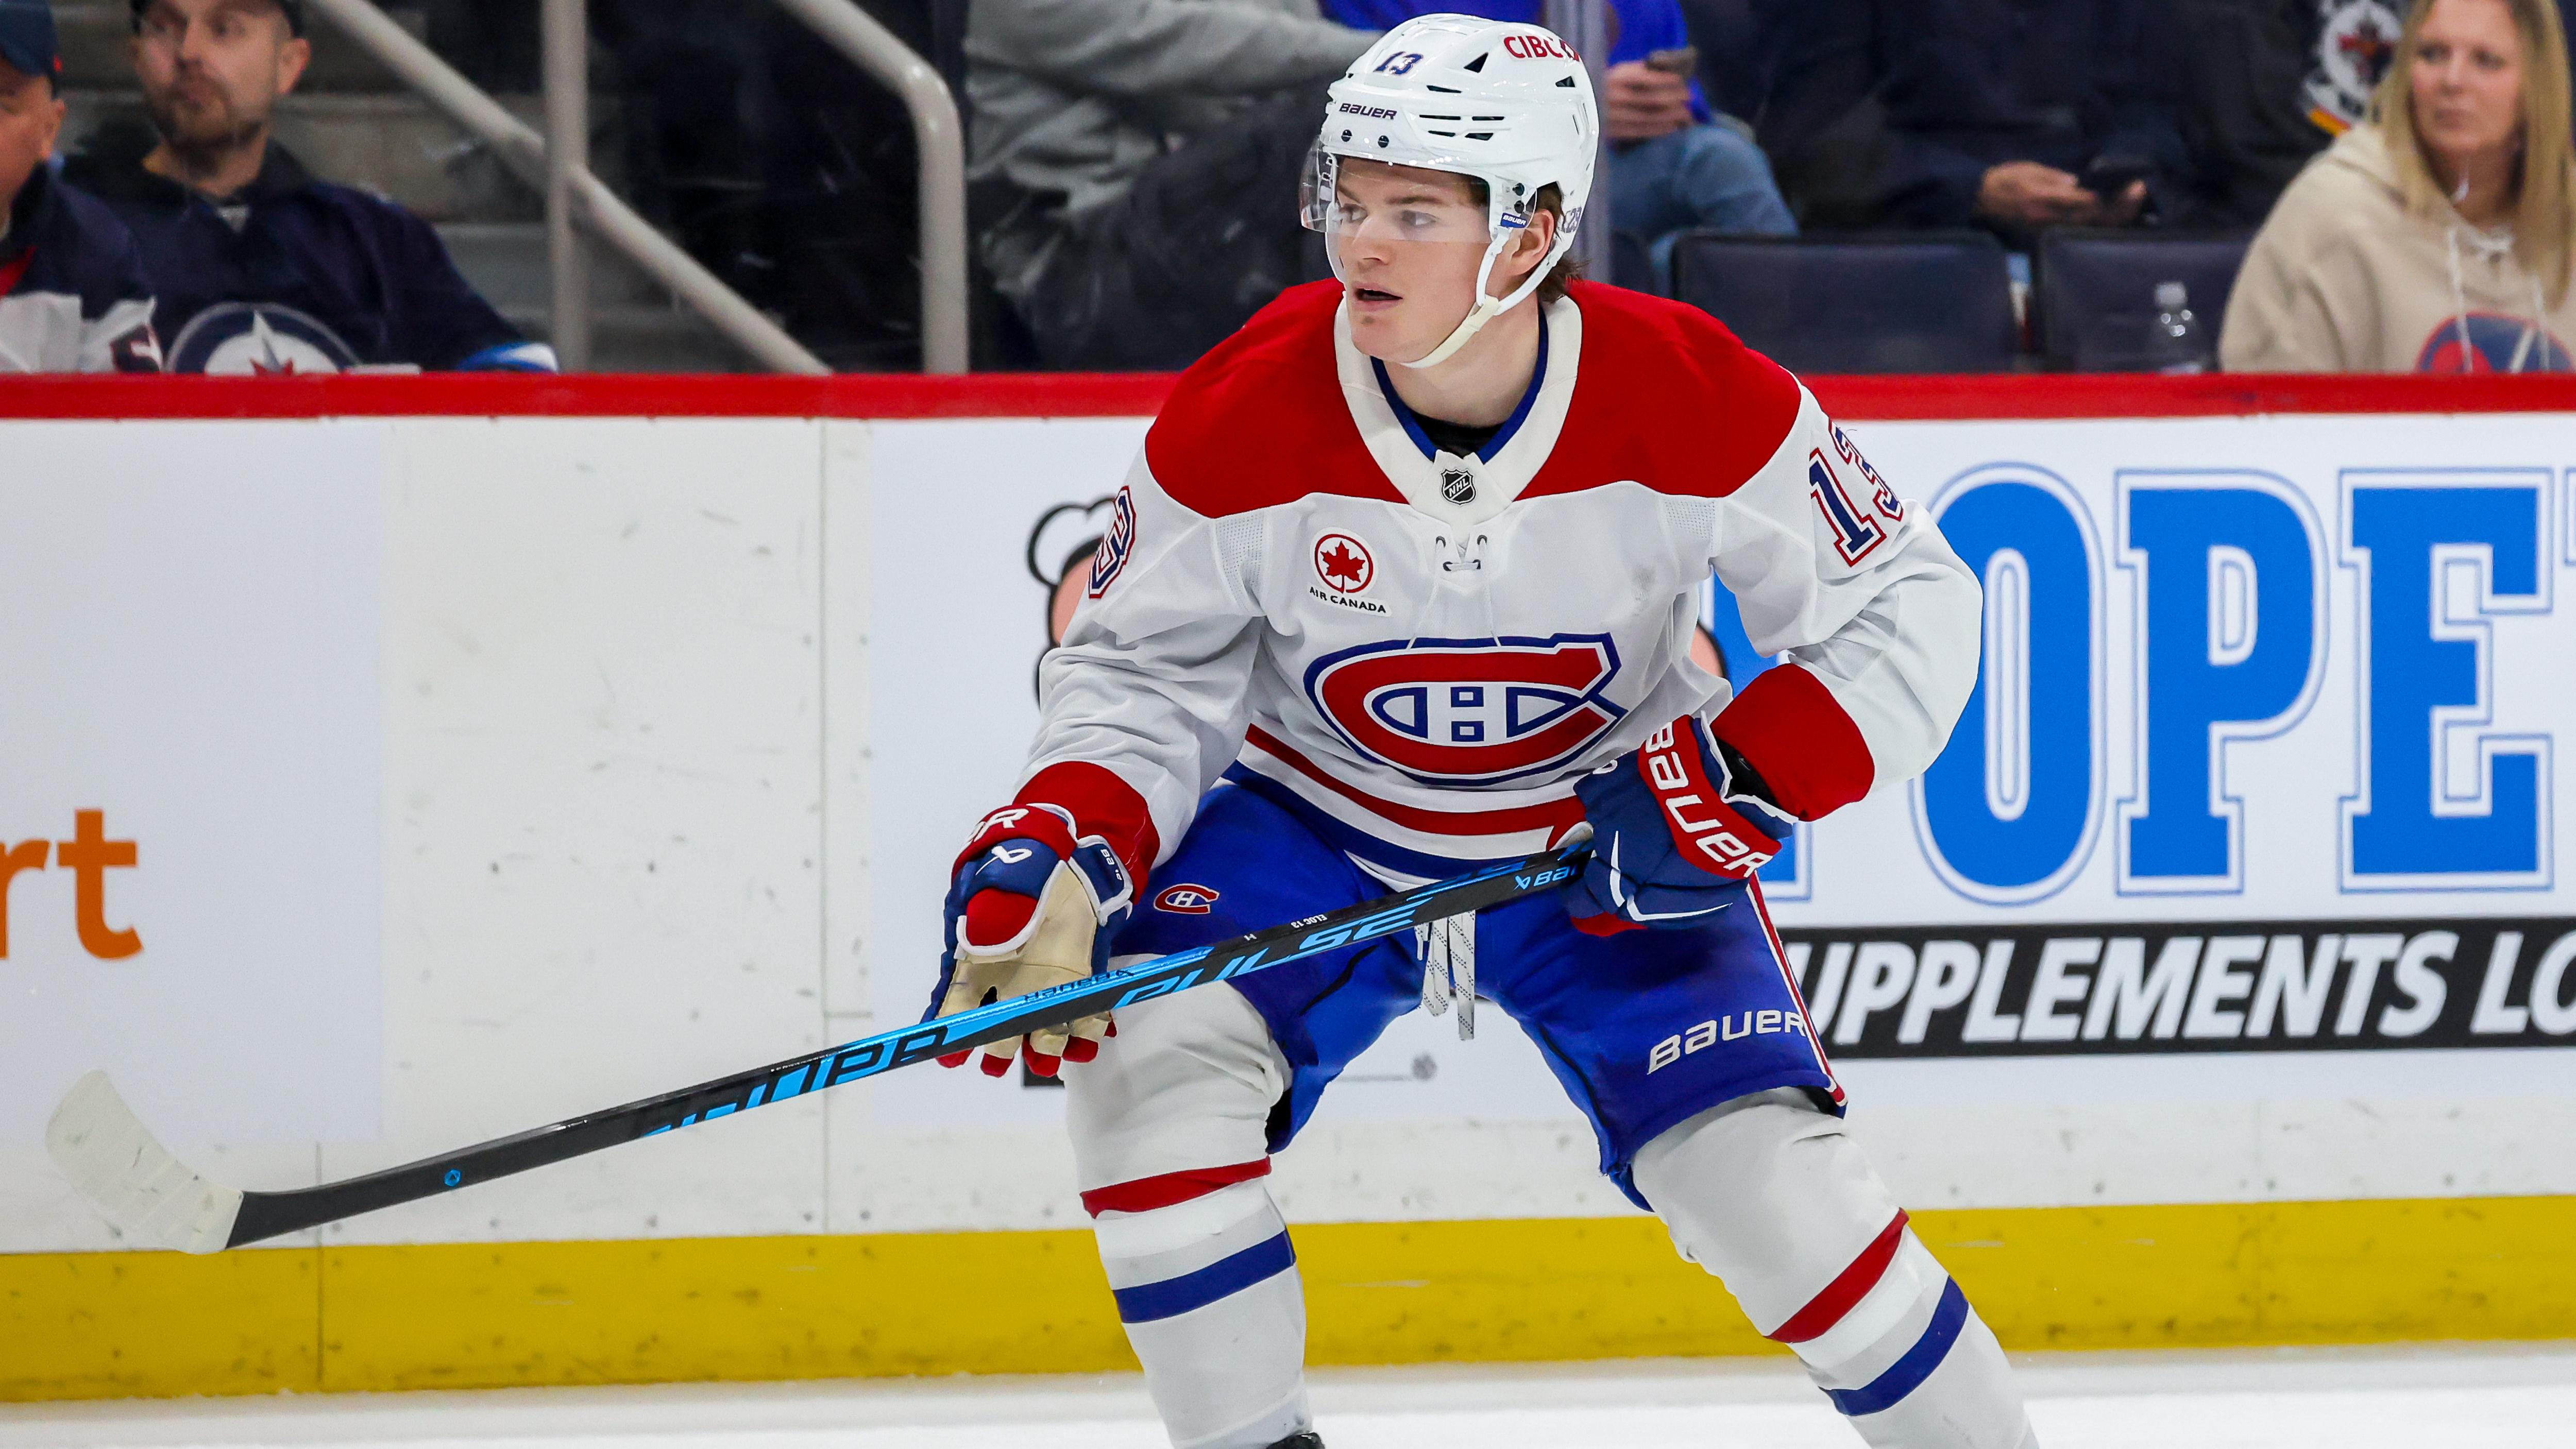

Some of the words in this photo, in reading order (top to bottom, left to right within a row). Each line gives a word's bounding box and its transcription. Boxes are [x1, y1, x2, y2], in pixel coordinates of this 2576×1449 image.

[1503, 35, 1563, 59] CIBC
[1373, 51, 1424, 76] 13
[1338, 103, 1398, 120] BAUER
[1502, 214, 1527, 226] BAUER
[1448, 478, 1469, 497] NHL
[1309, 586, 1328, 601] AIR
[1330, 595, 1386, 613] CANADA
[1698, 460, 2576, 907] OPE
[1646, 722, 1774, 878] BAUER
[1113, 896, 1433, 1009] PULSE
[1647, 1010, 1807, 1076] BAUER
